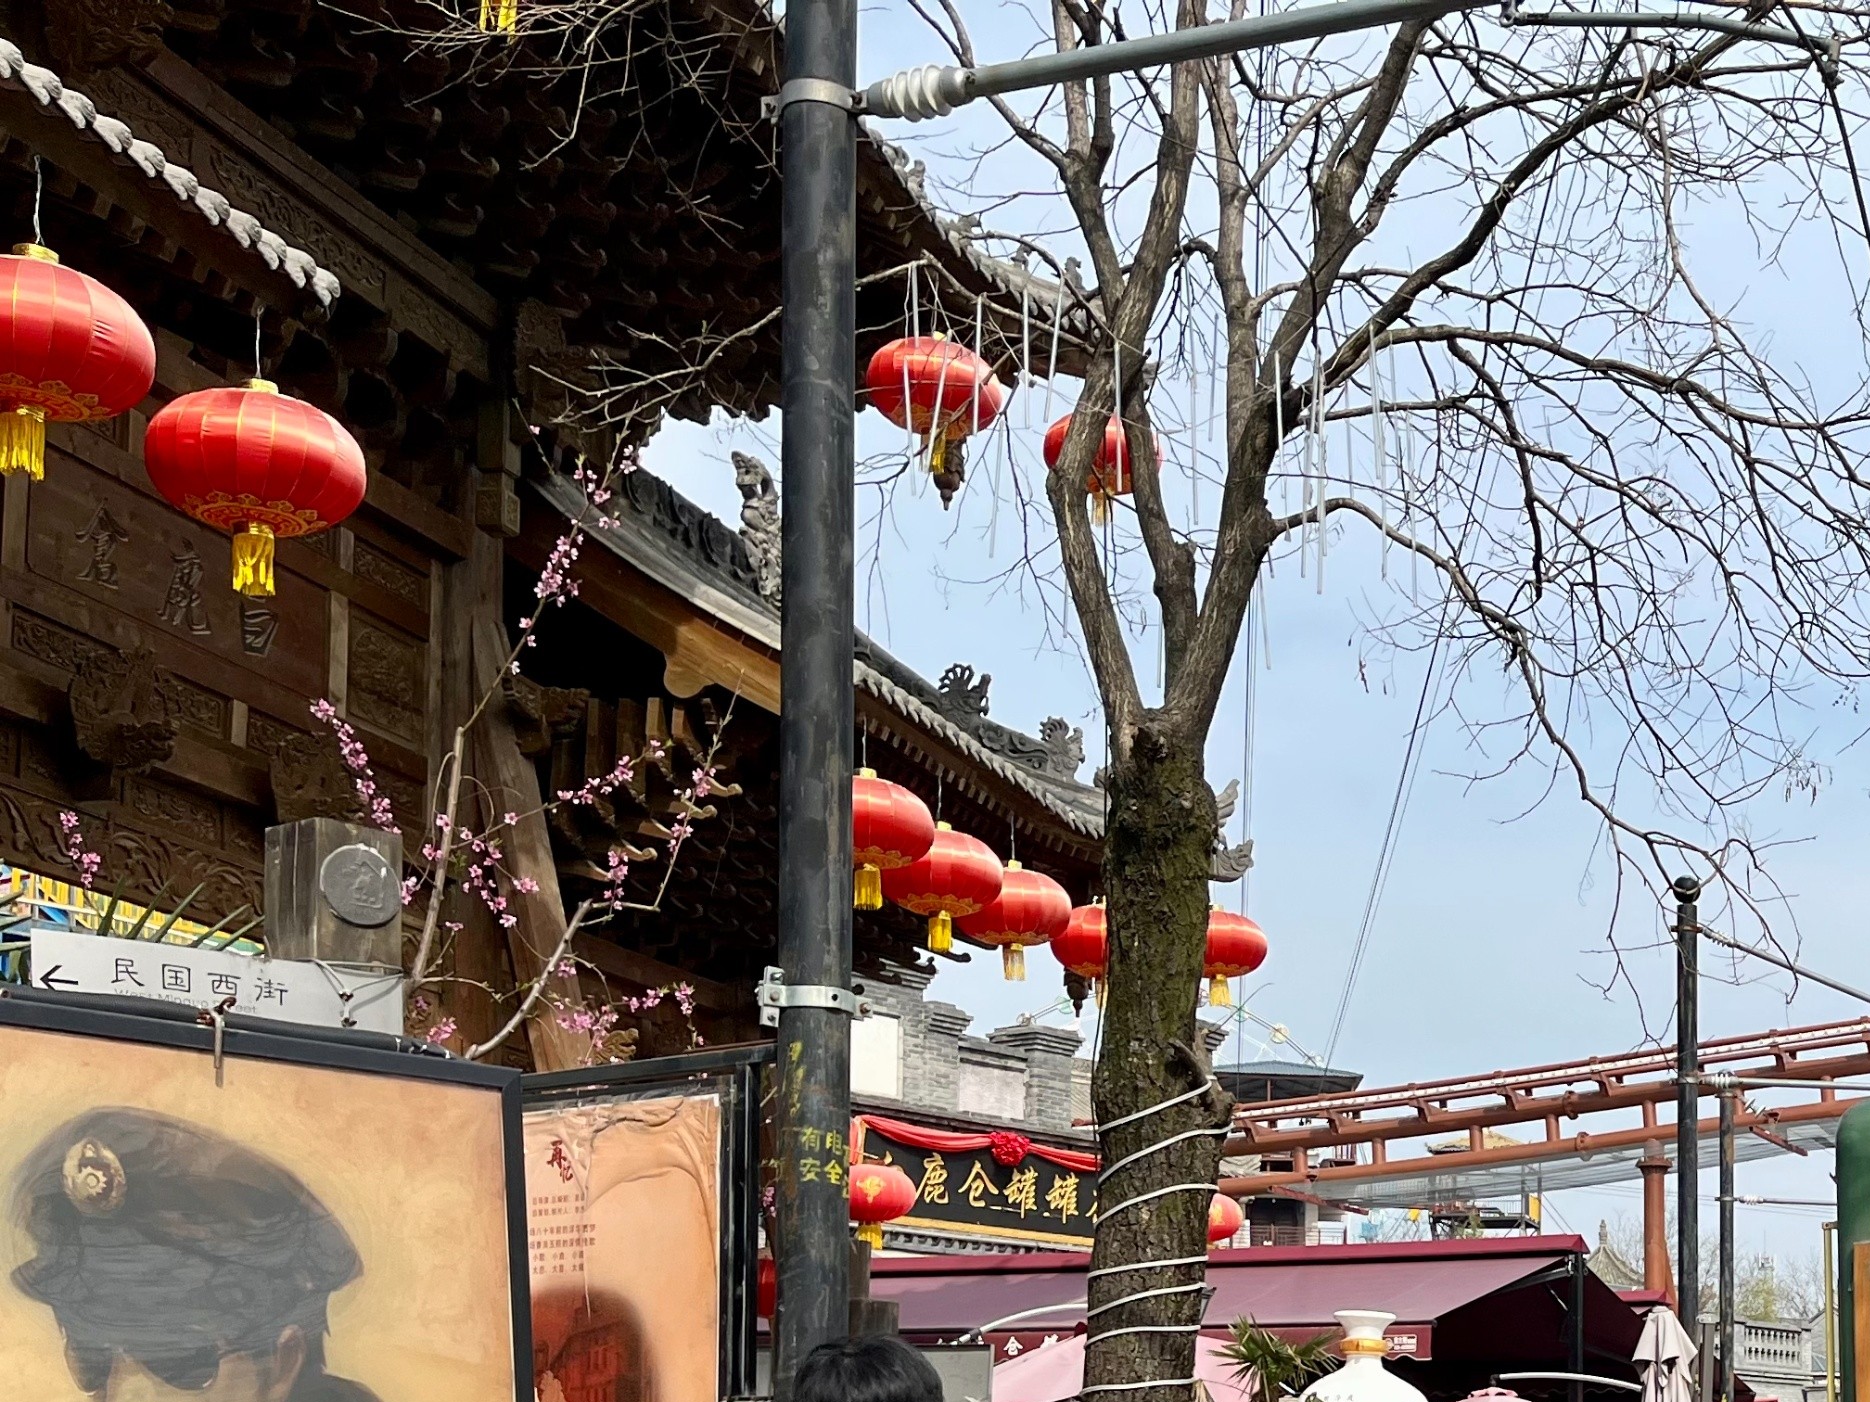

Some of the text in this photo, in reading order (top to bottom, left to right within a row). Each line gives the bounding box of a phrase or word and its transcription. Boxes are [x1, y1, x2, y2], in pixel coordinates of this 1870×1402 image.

[110, 957, 289, 1006] 民国西街
[881, 1151, 1101, 1226] 鹿仓罐罐
